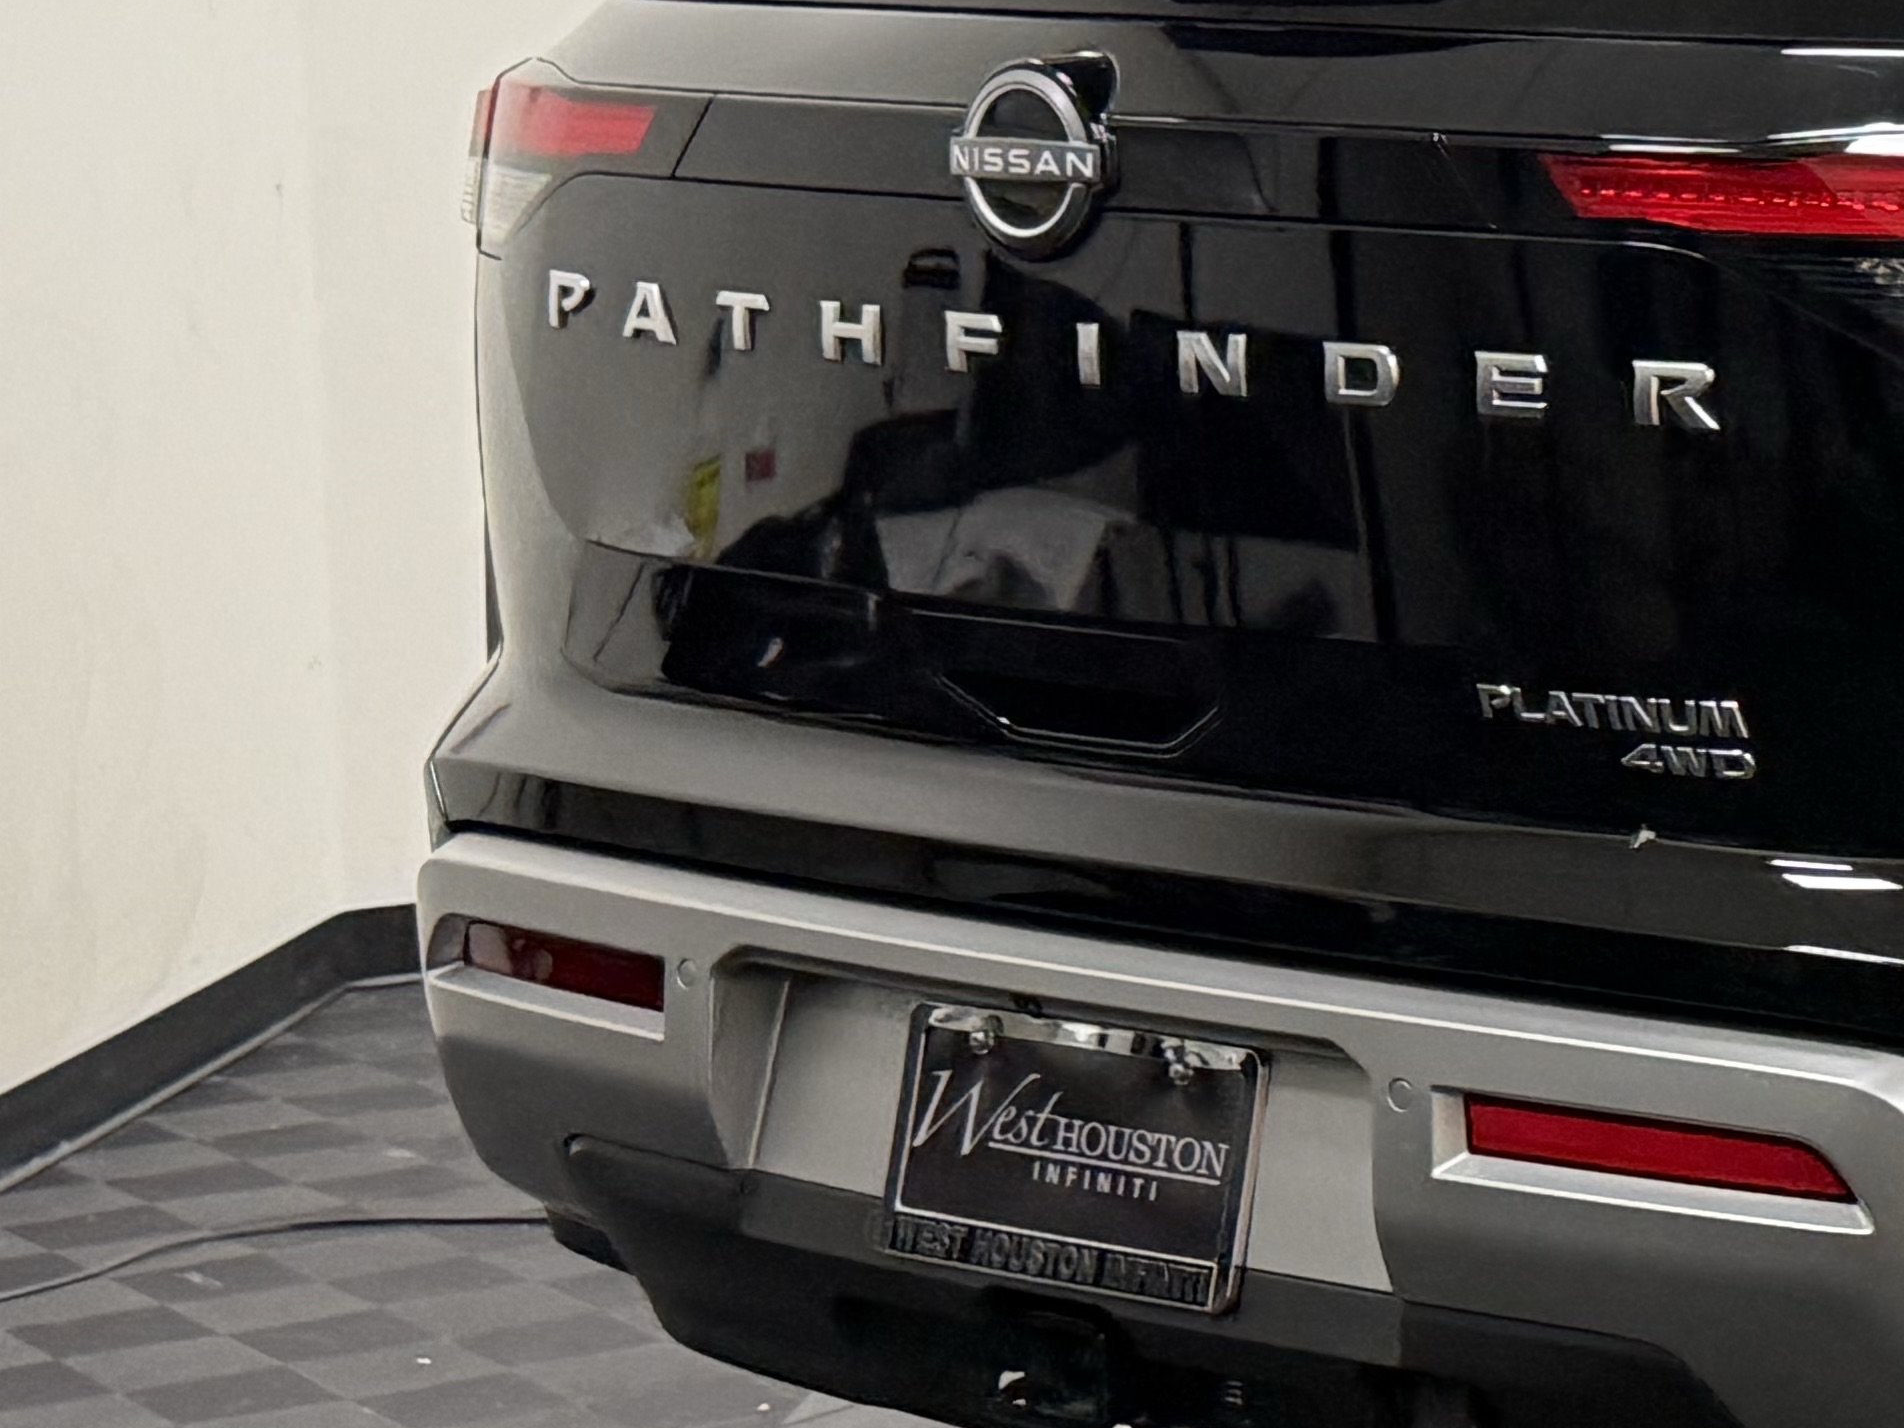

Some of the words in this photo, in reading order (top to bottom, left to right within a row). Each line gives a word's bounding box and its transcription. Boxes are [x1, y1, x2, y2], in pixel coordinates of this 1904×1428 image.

[952, 143, 1096, 179] NISSAN
[548, 268, 1721, 431] PATHFINDER
[1476, 682, 1749, 739] PLATINUM
[1621, 742, 1756, 779] 4WD
[912, 1070, 1063, 1156] West
[1053, 1117, 1230, 1177] HOUSTON
[1033, 1161, 1158, 1202] INFINITI
[896, 1215, 969, 1260] WEST
[969, 1228, 1099, 1284] HOUSTON
